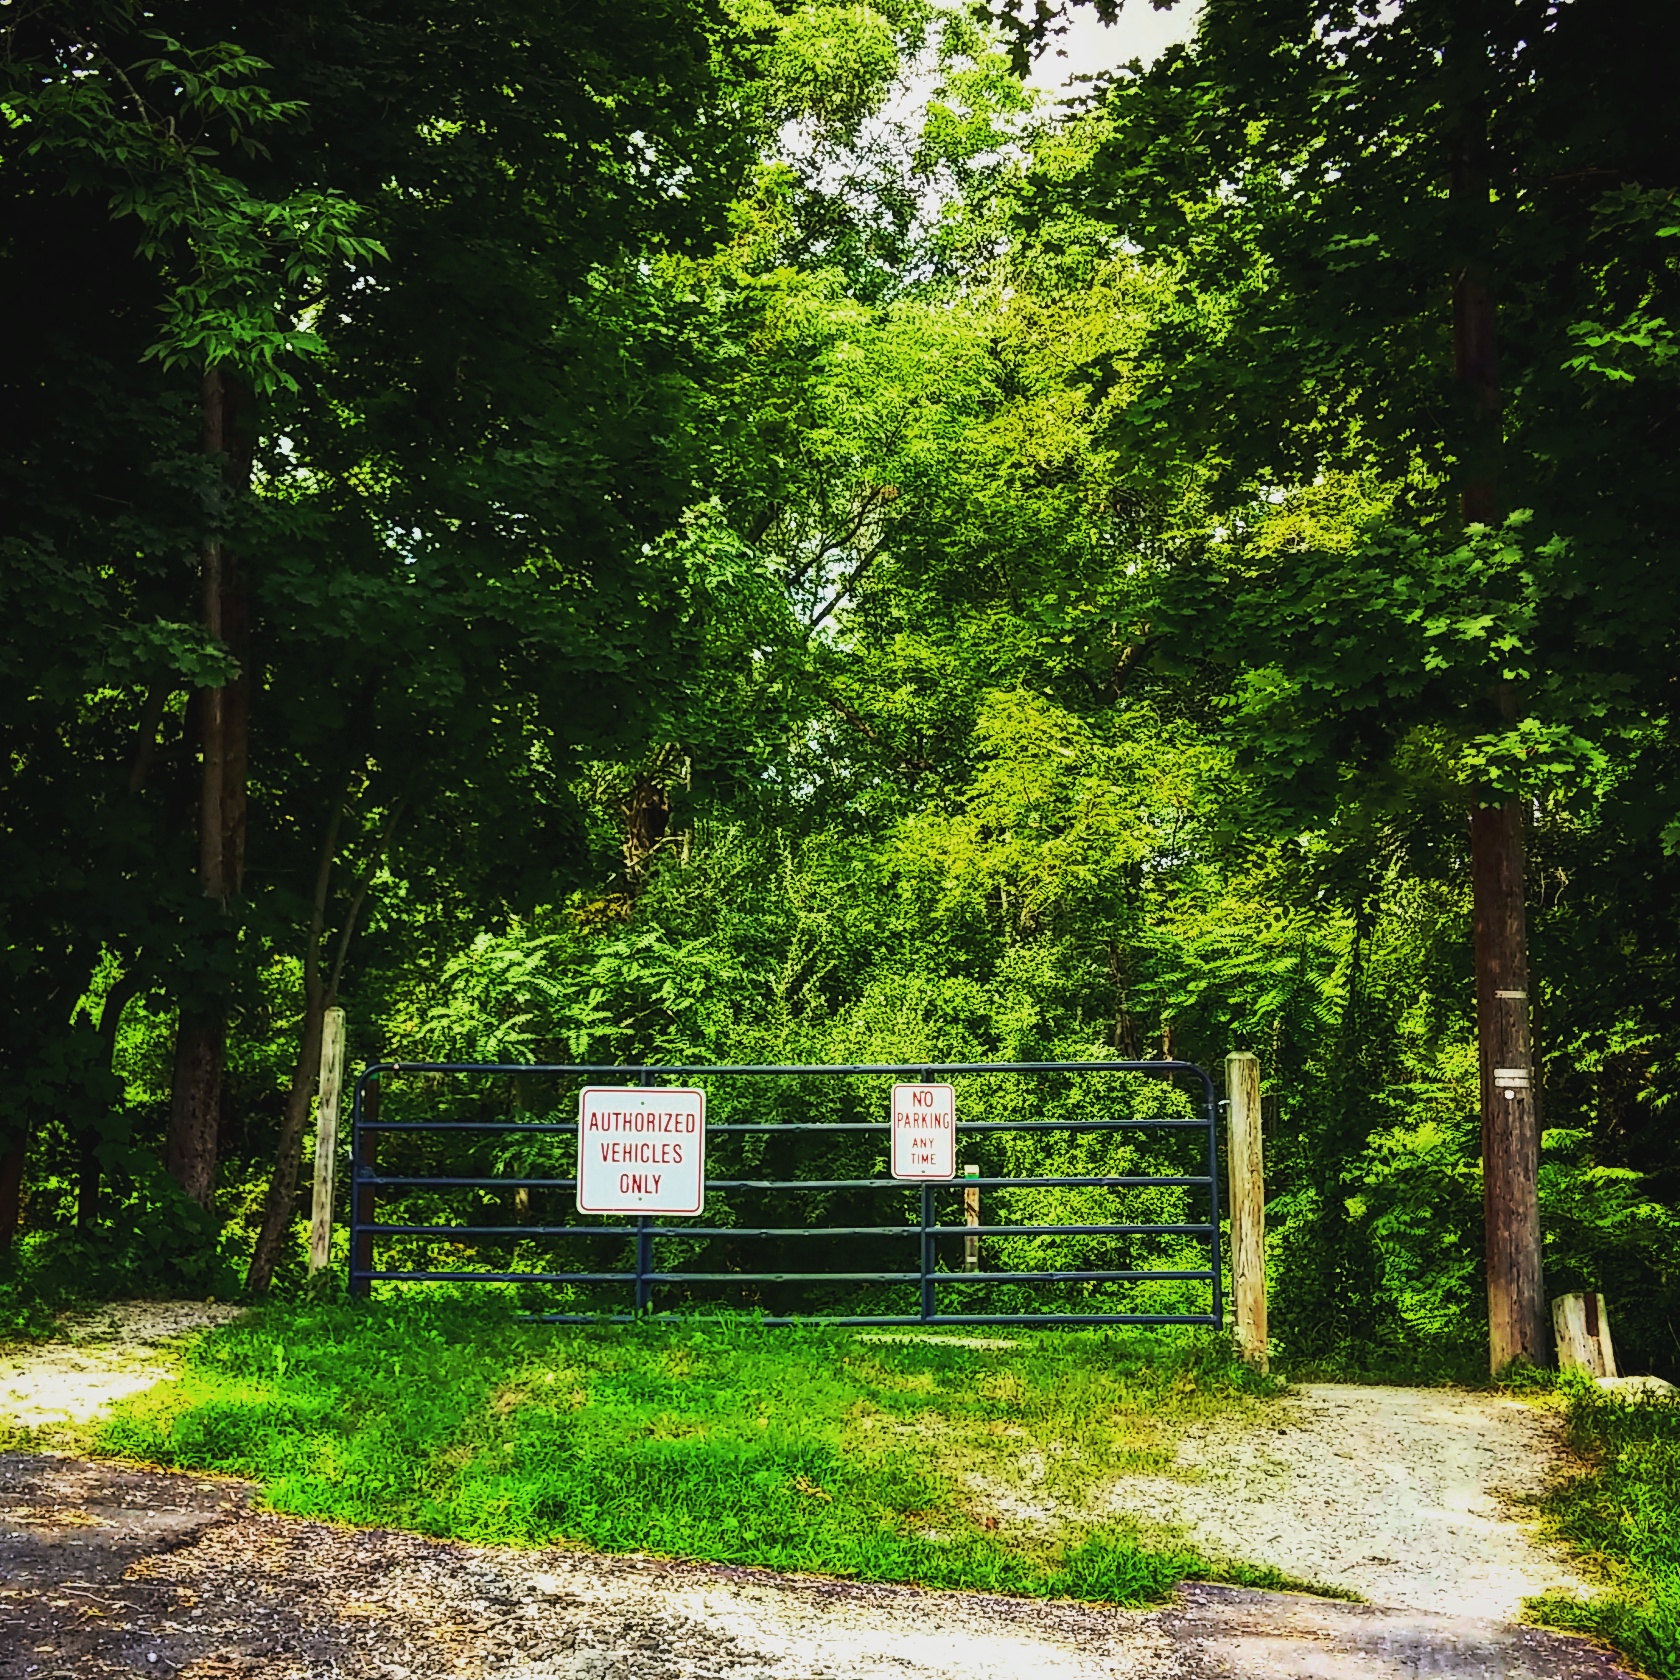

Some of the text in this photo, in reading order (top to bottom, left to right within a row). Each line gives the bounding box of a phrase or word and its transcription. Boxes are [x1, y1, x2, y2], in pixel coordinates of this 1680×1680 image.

[912, 1090, 934, 1108] NO
[589, 1111, 696, 1134] AUTHORIZED
[897, 1112, 950, 1130] PARKING
[911, 1137, 935, 1149] ANY
[600, 1142, 683, 1164] VEHICLES
[911, 1153, 937, 1166] TIME
[619, 1173, 662, 1195] ONLY
